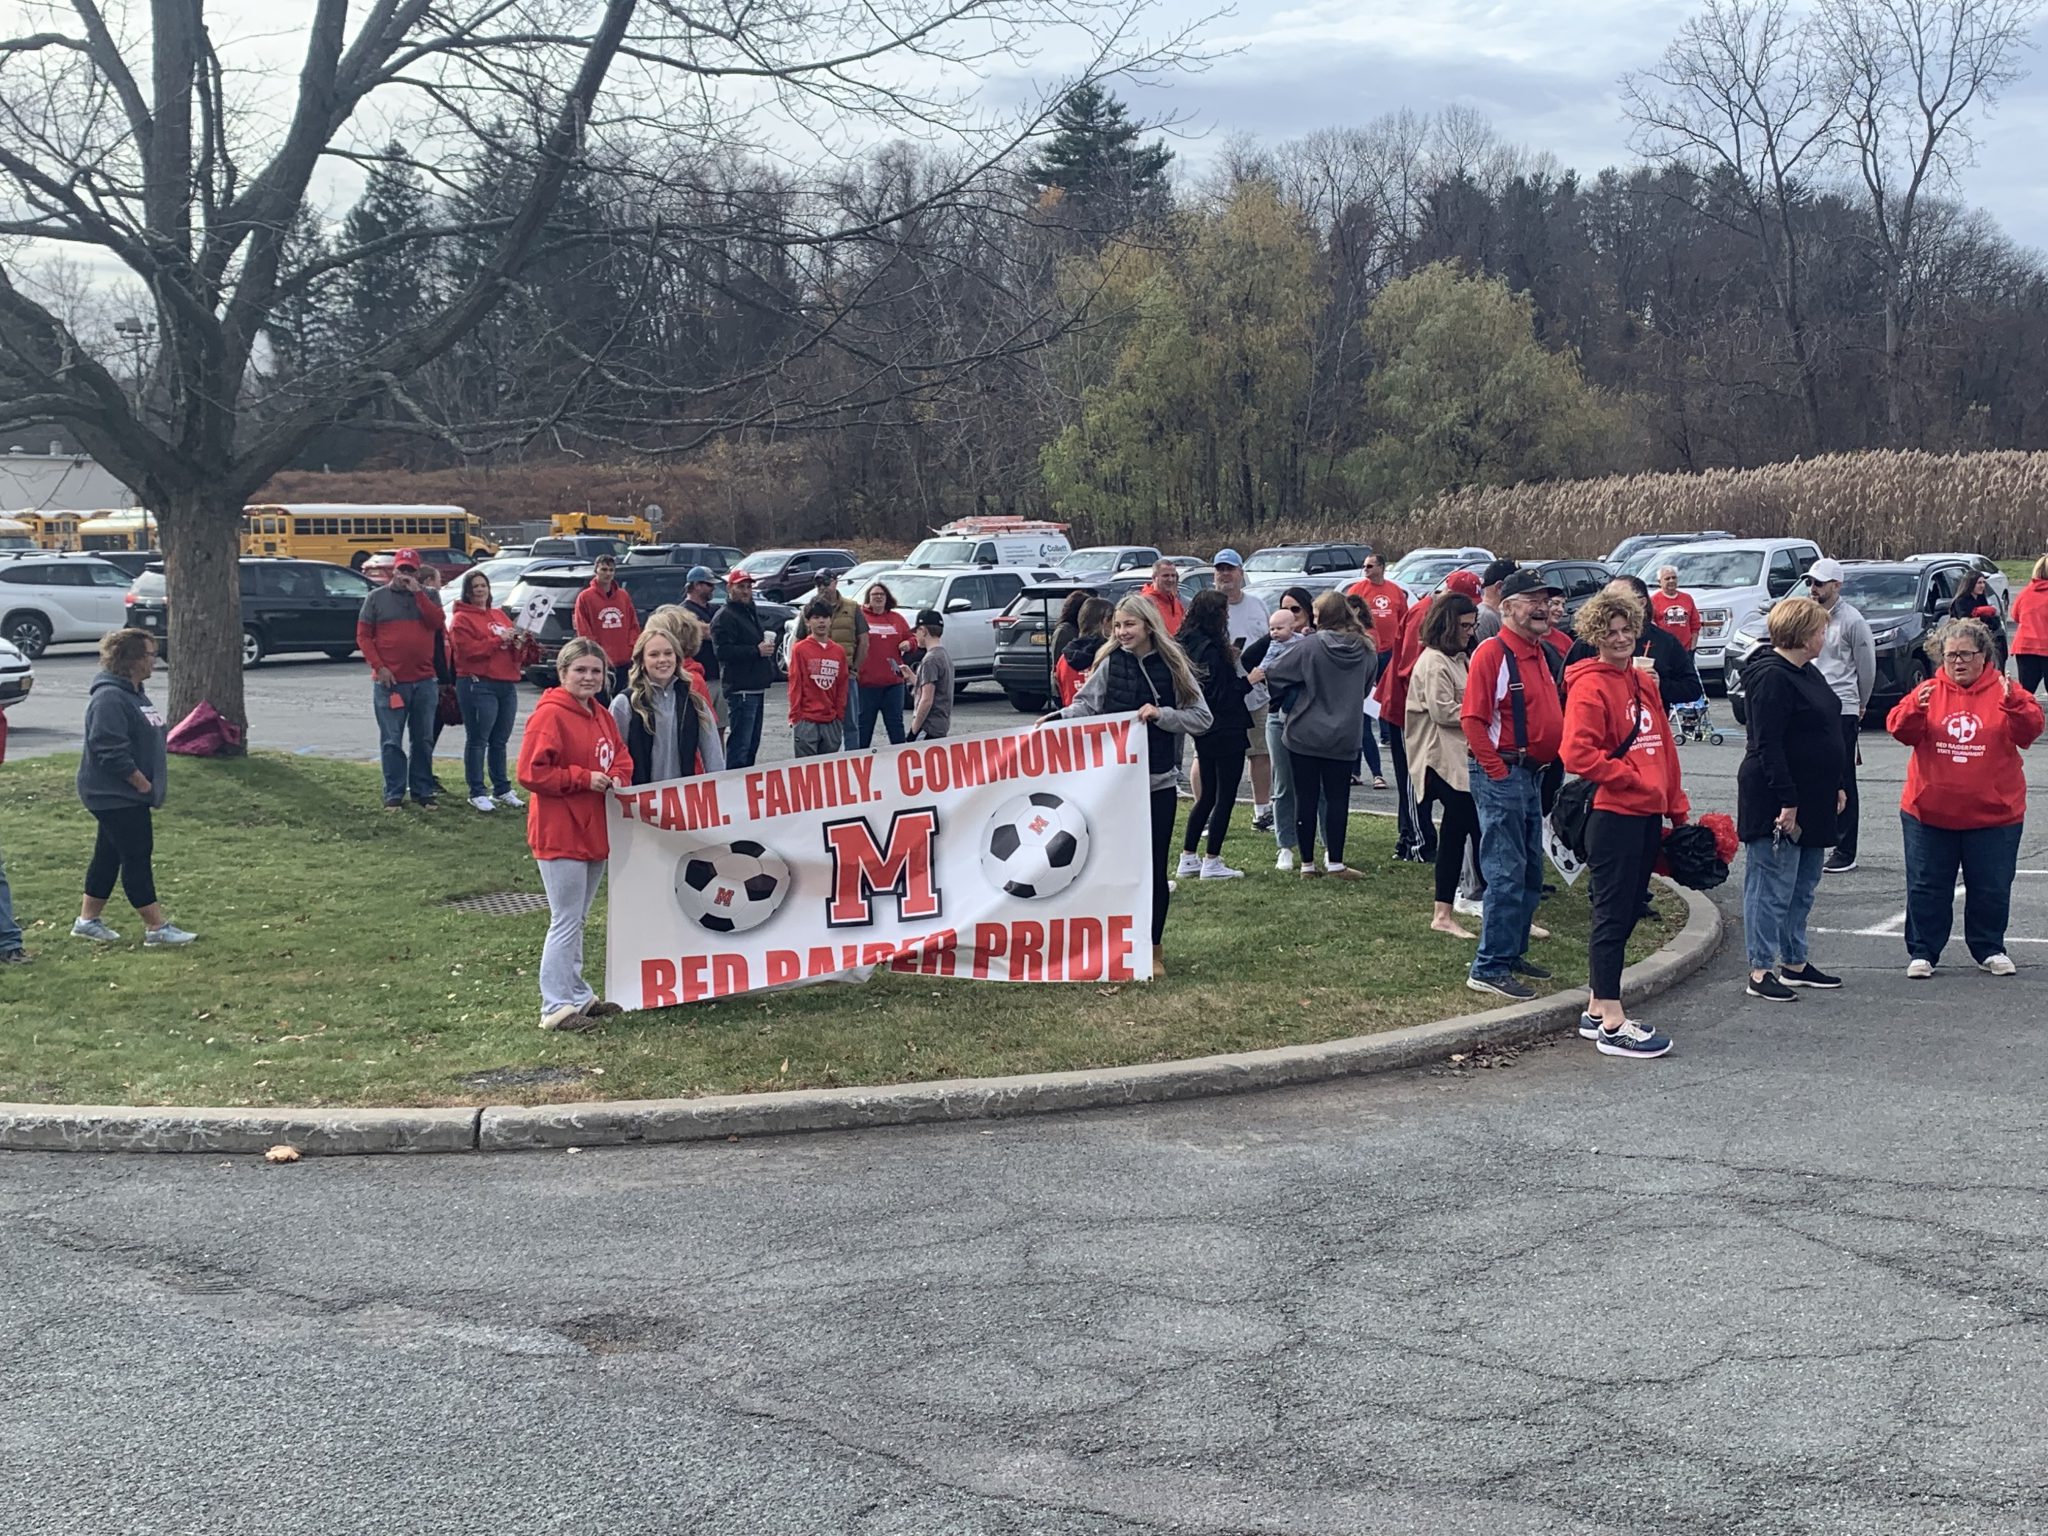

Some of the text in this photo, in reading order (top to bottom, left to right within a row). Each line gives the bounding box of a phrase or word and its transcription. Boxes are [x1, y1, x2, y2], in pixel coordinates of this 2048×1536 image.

[614, 720, 1138, 832] TEAM. FAMILY. COMMUNITY.
[714, 886, 735, 907] M
[822, 806, 942, 928] M
[972, 915, 1135, 981] PRIDE
